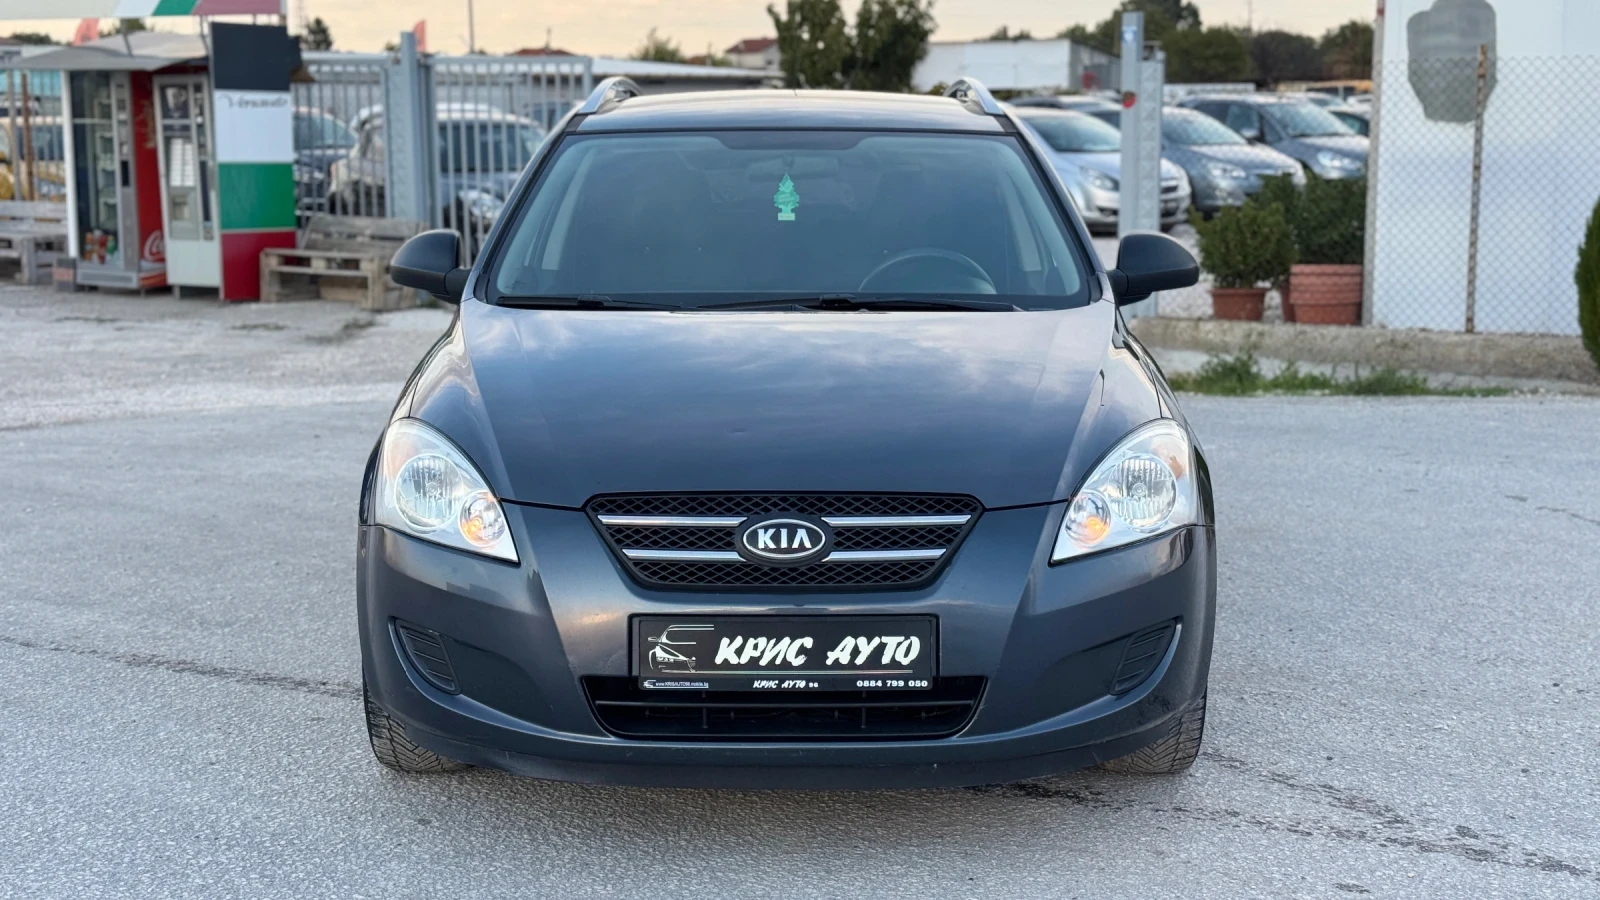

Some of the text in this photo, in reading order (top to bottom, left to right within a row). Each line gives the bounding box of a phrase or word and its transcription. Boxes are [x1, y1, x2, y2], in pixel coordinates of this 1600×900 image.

[757, 528, 813, 549] KIA
[714, 635, 921, 666] КРИС АУТО
[753, 680, 778, 688] КРИС
[781, 680, 806, 688] АУТО
